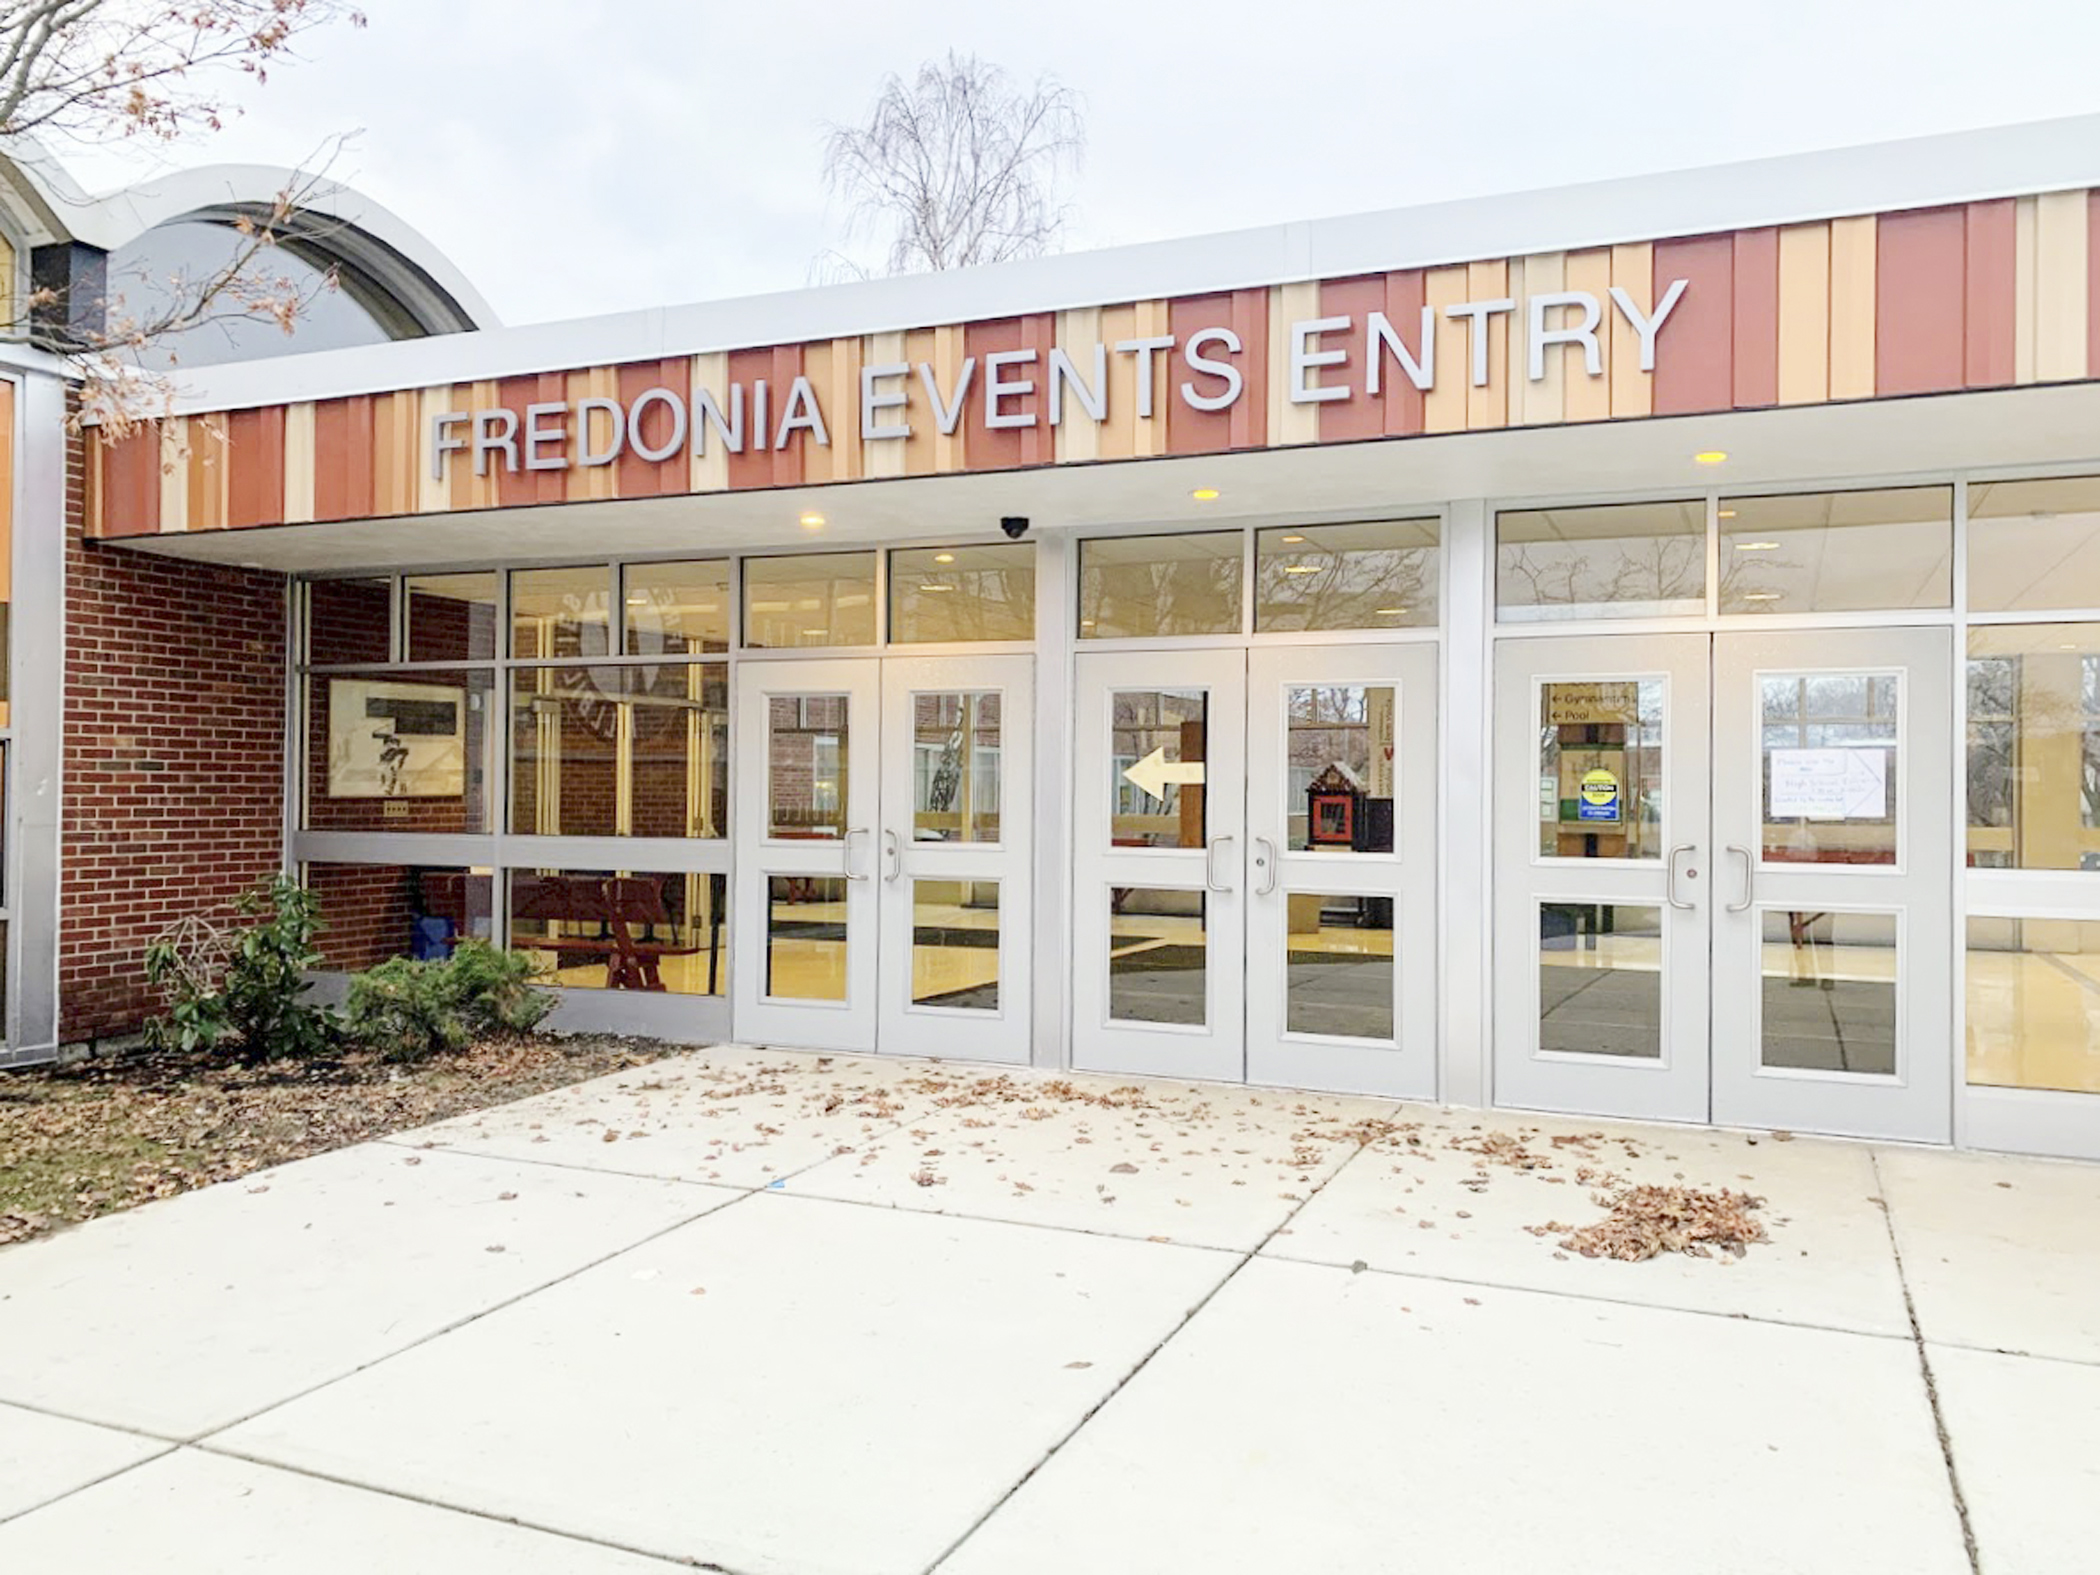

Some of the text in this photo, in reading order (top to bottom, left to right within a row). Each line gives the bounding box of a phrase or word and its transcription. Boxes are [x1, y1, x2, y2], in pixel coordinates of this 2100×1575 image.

[430, 279, 1689, 479] FREDONIA EVENTS ENTRY
[1564, 709, 1590, 721] Pool
